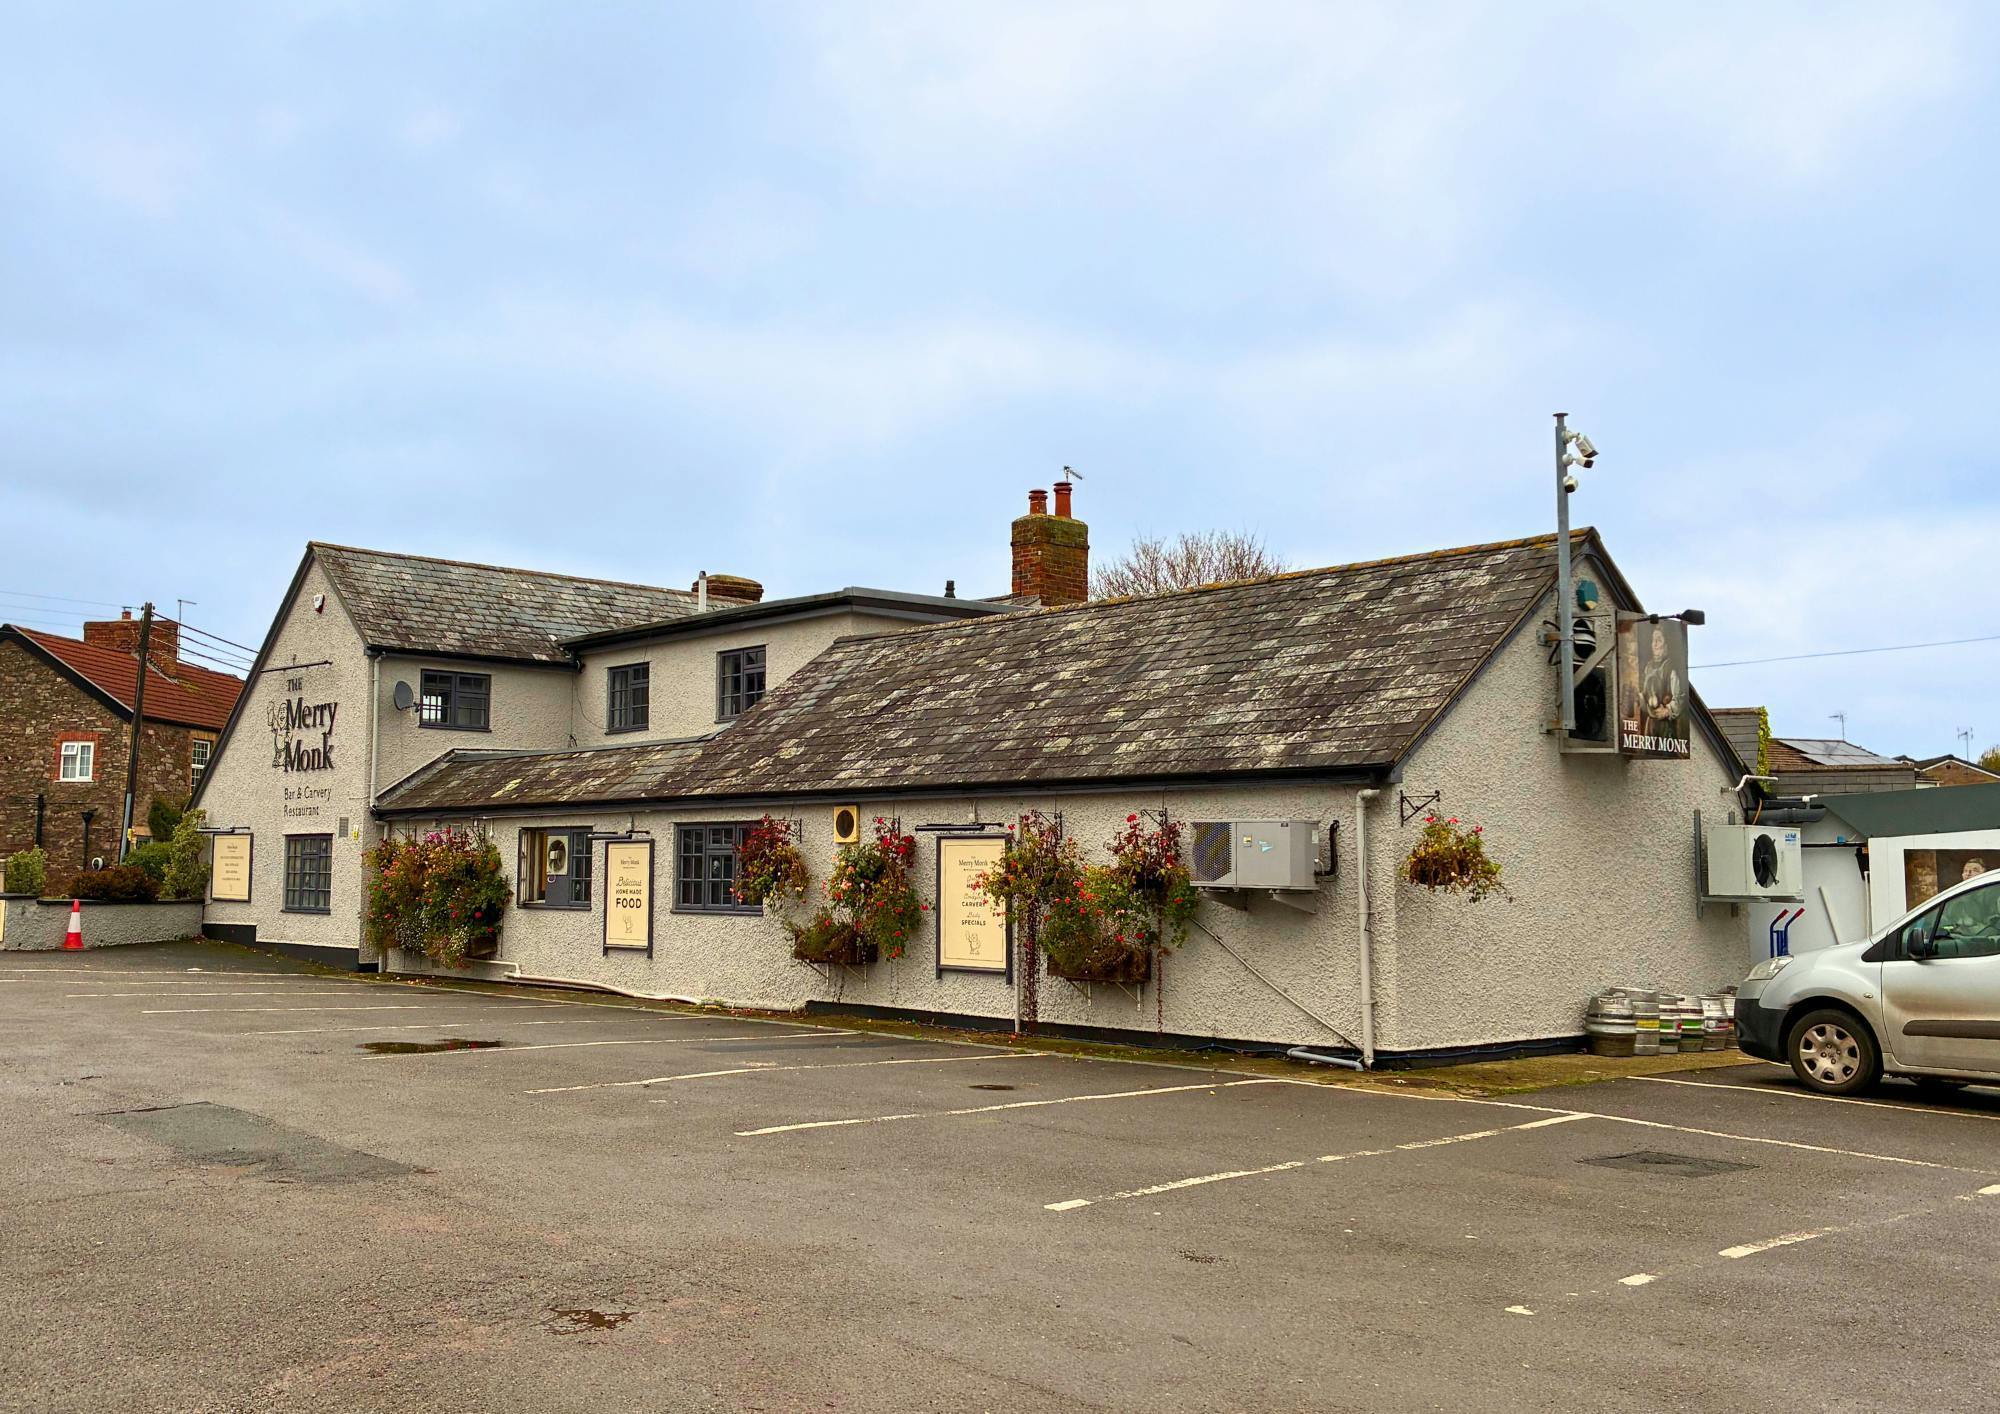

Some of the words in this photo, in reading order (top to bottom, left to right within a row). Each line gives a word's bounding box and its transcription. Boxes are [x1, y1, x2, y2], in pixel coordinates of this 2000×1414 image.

[287, 677, 303, 692] THE
[285, 697, 338, 735] Merry
[1623, 719, 1639, 731] THE
[1623, 733, 1657, 751] MERRY
[1658, 737, 1688, 753] MONK
[283, 732, 335, 773] Monk
[284, 787, 295, 800] Bar
[297, 786, 302, 799] &
[304, 785, 331, 802] Carvery
[283, 804, 319, 817] Restaurant
[616, 898, 642, 908] FOOD
